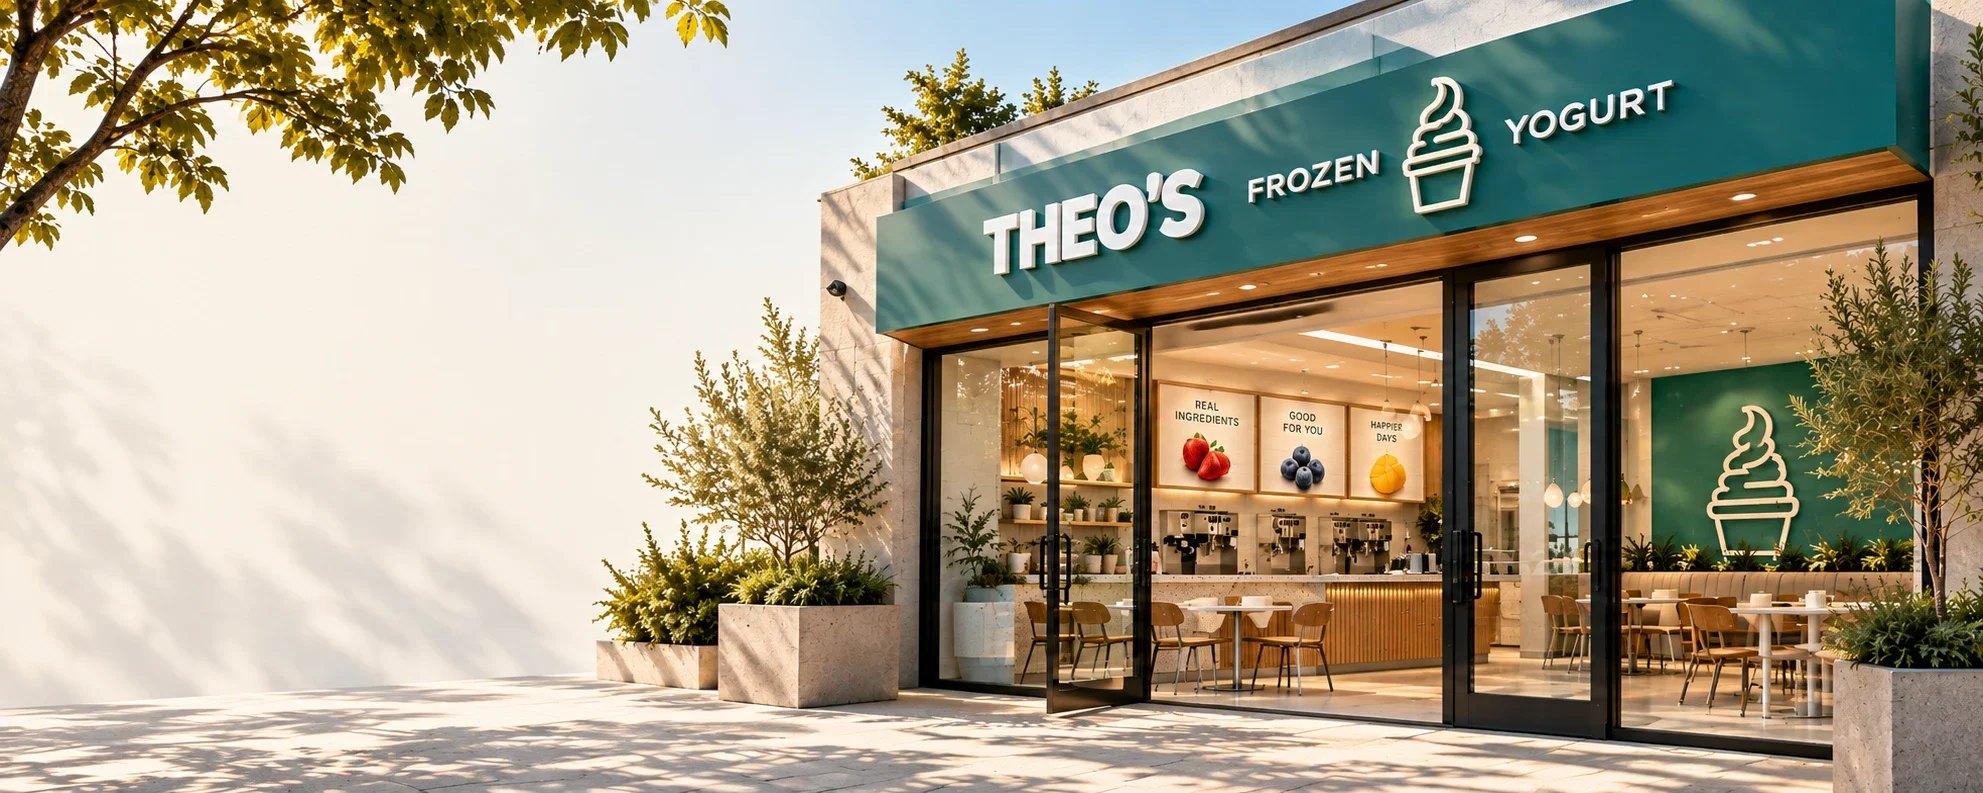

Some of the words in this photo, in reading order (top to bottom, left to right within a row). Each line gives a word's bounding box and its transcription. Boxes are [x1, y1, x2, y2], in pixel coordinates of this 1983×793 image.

[1247, 149, 1381, 204] FROZEN
[1504, 79, 1675, 145] YOGURT
[1195, 400, 1219, 412] REAL
[1175, 410, 1240, 427] INGREDIENTS
[1289, 411, 1316, 423] GOOD
[1283, 423, 1303, 434] FOR
[1304, 424, 1323, 436] YOU
[1370, 420, 1403, 432] HAPPIER
[1376, 433, 1398, 443] DAYS
